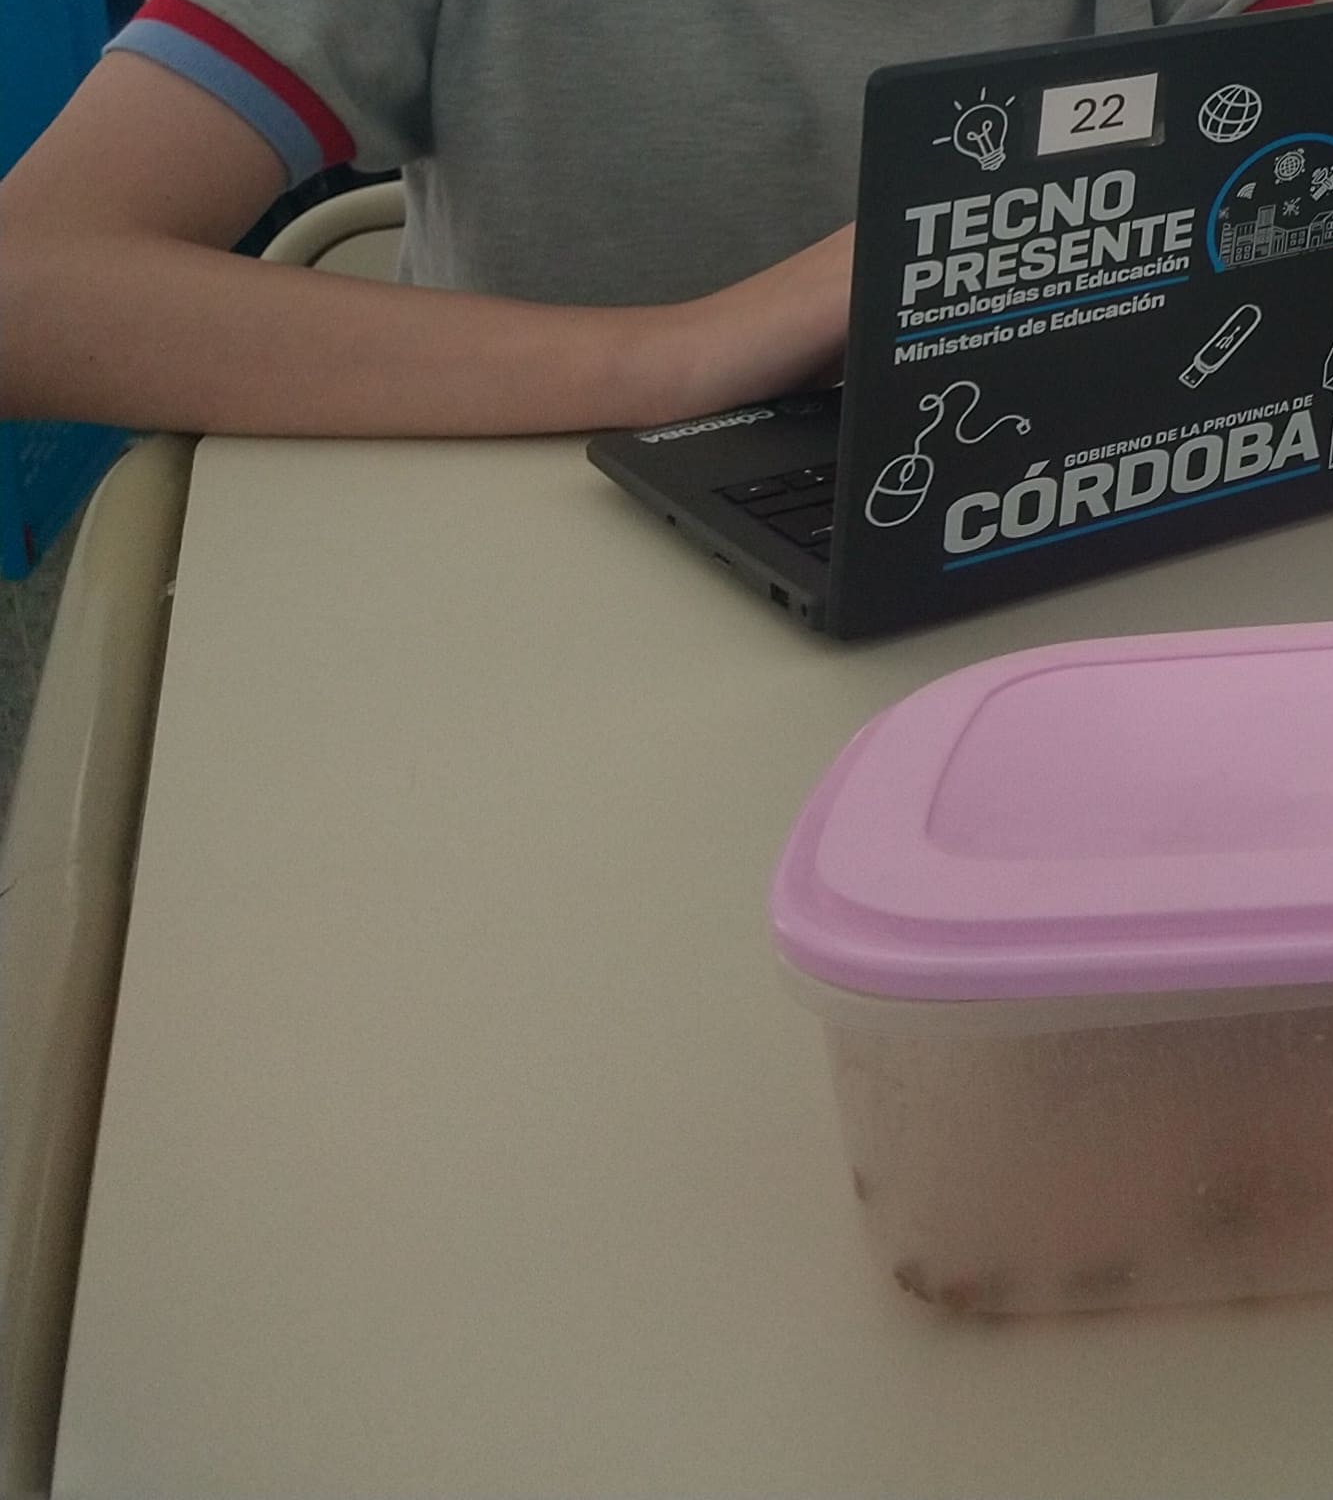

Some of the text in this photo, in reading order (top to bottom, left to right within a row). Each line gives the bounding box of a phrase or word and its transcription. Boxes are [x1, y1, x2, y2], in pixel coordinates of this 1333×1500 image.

[1070, 93, 1125, 134] 22
[905, 169, 1136, 257] TECNO
[897, 255, 1191, 329] Tecnologías en Educación
[901, 208, 1196, 307] PRESENTE
[894, 292, 1167, 366] Ministerio de Educación
[1063, 394, 1314, 468] GOBIERNO DE LA PROVINCIA DE
[942, 409, 1321, 555] CÓRDOBA
